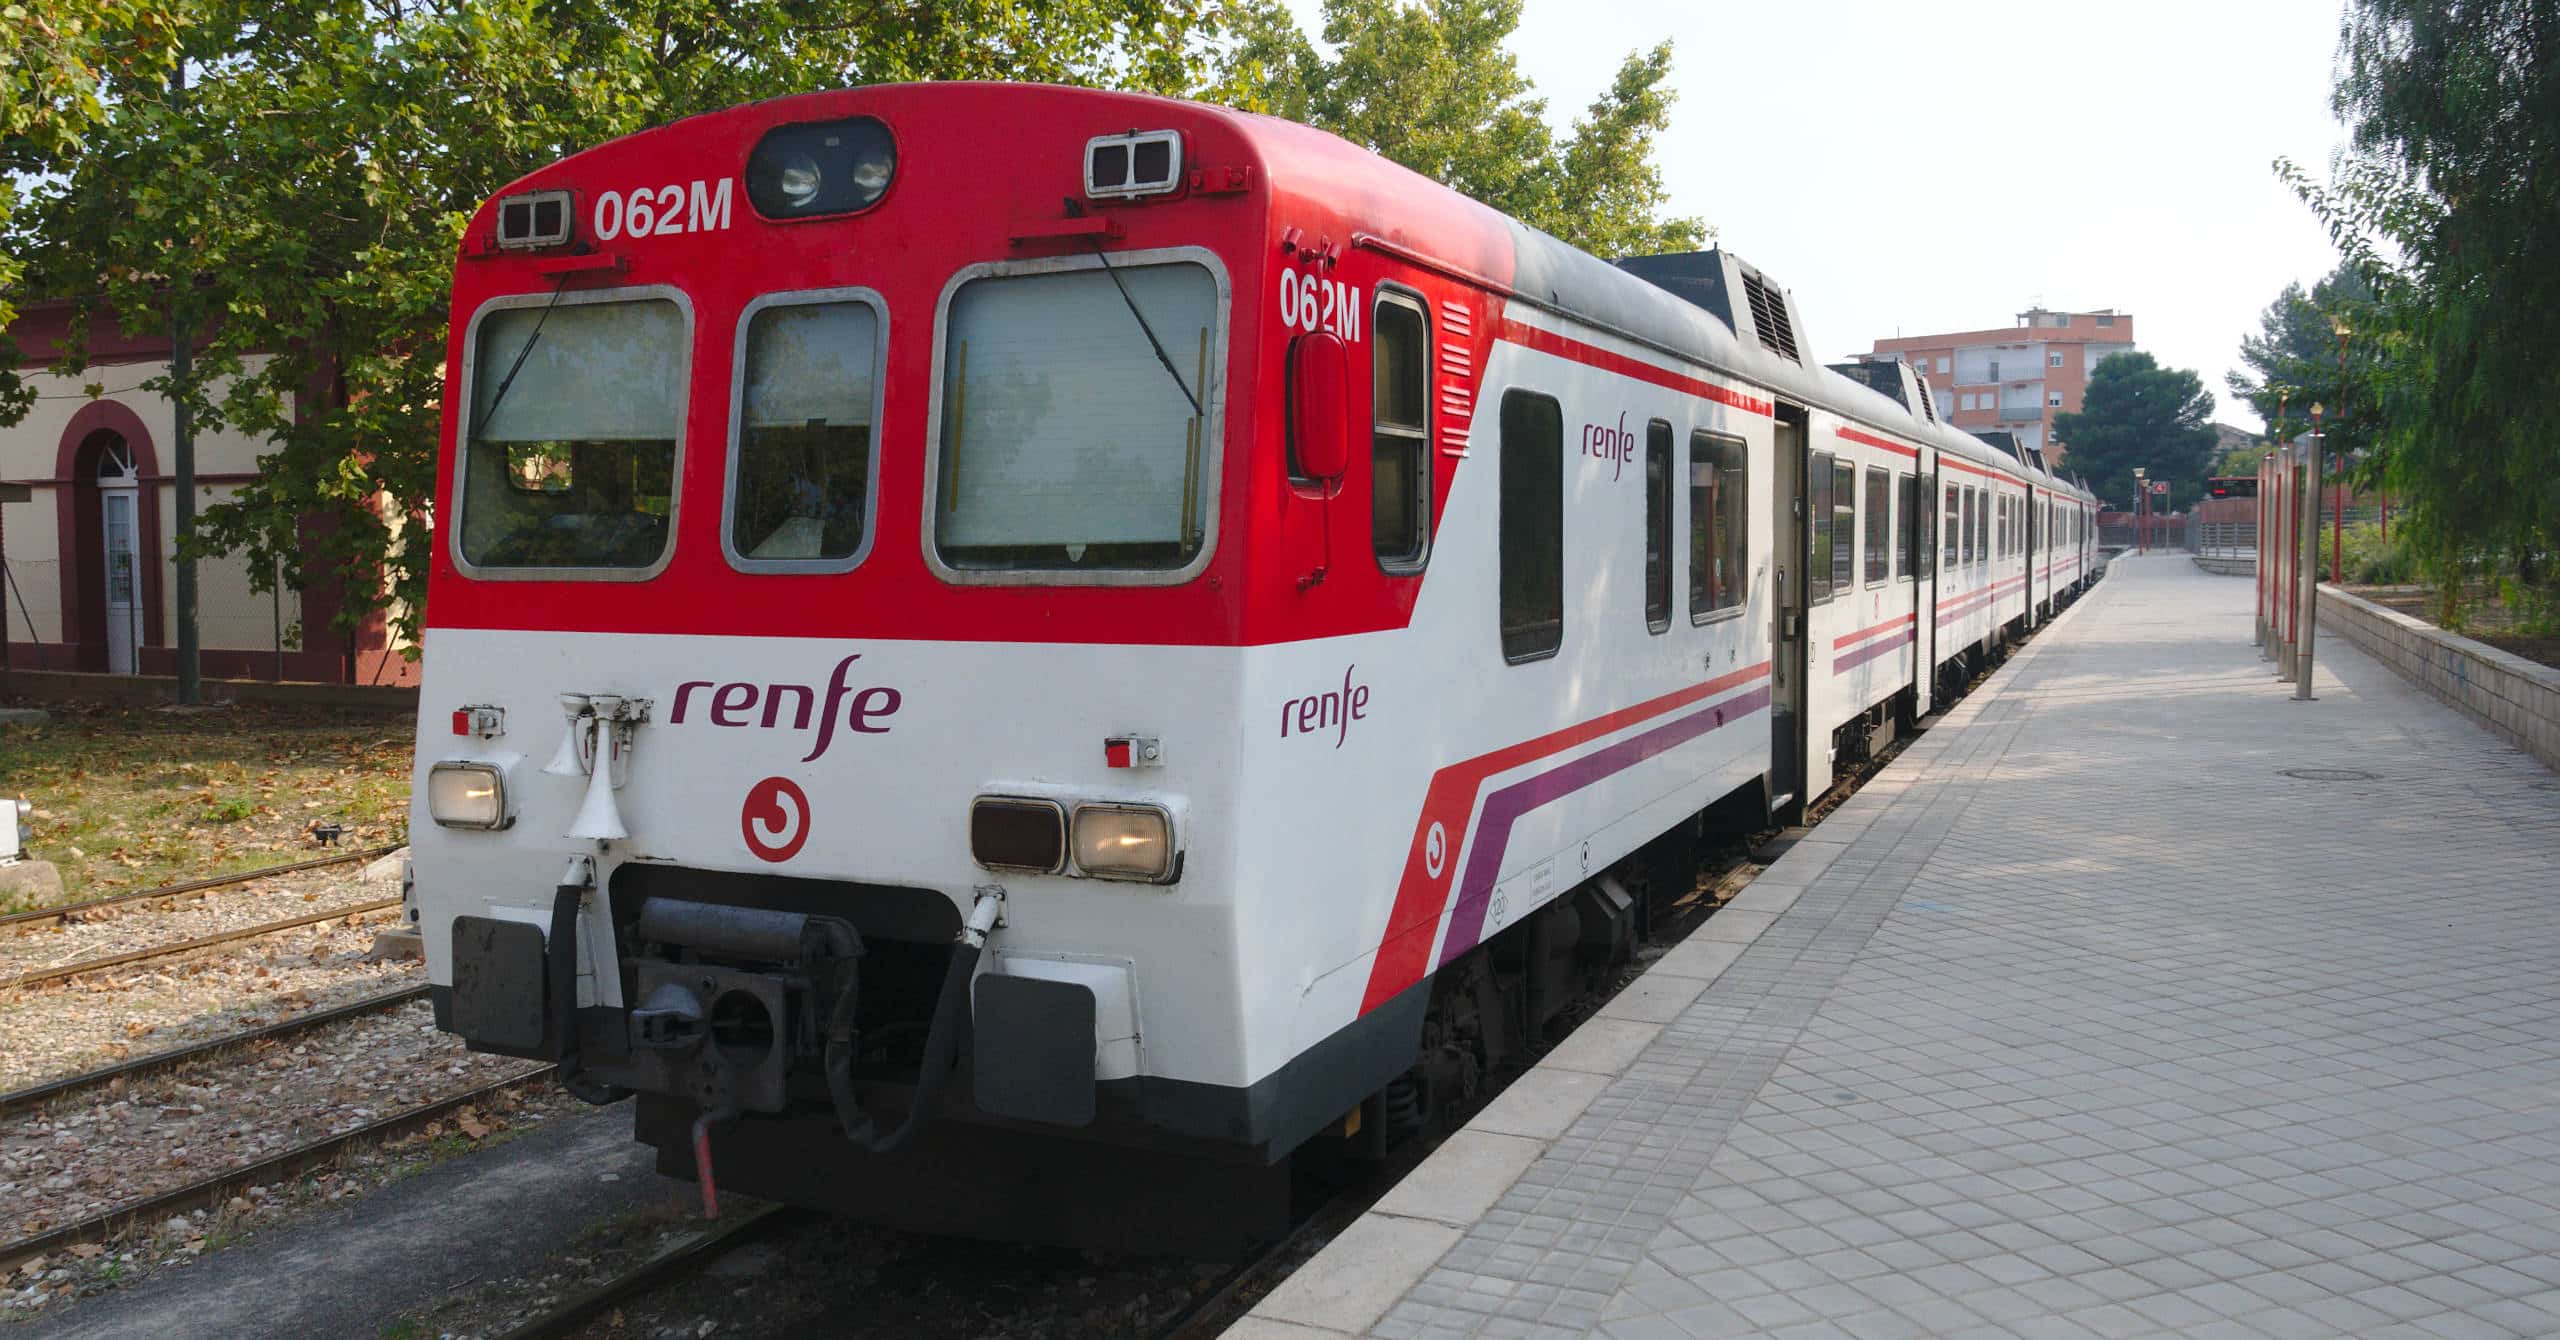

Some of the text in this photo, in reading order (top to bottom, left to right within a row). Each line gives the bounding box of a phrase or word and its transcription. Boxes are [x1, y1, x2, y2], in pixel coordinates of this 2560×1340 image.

[594, 177, 733, 241] 062M
[1280, 267, 1360, 343] 062M
[1582, 410, 1634, 482] renfe
[670, 654, 902, 763] renfe
[1281, 663, 1369, 750] renfe
